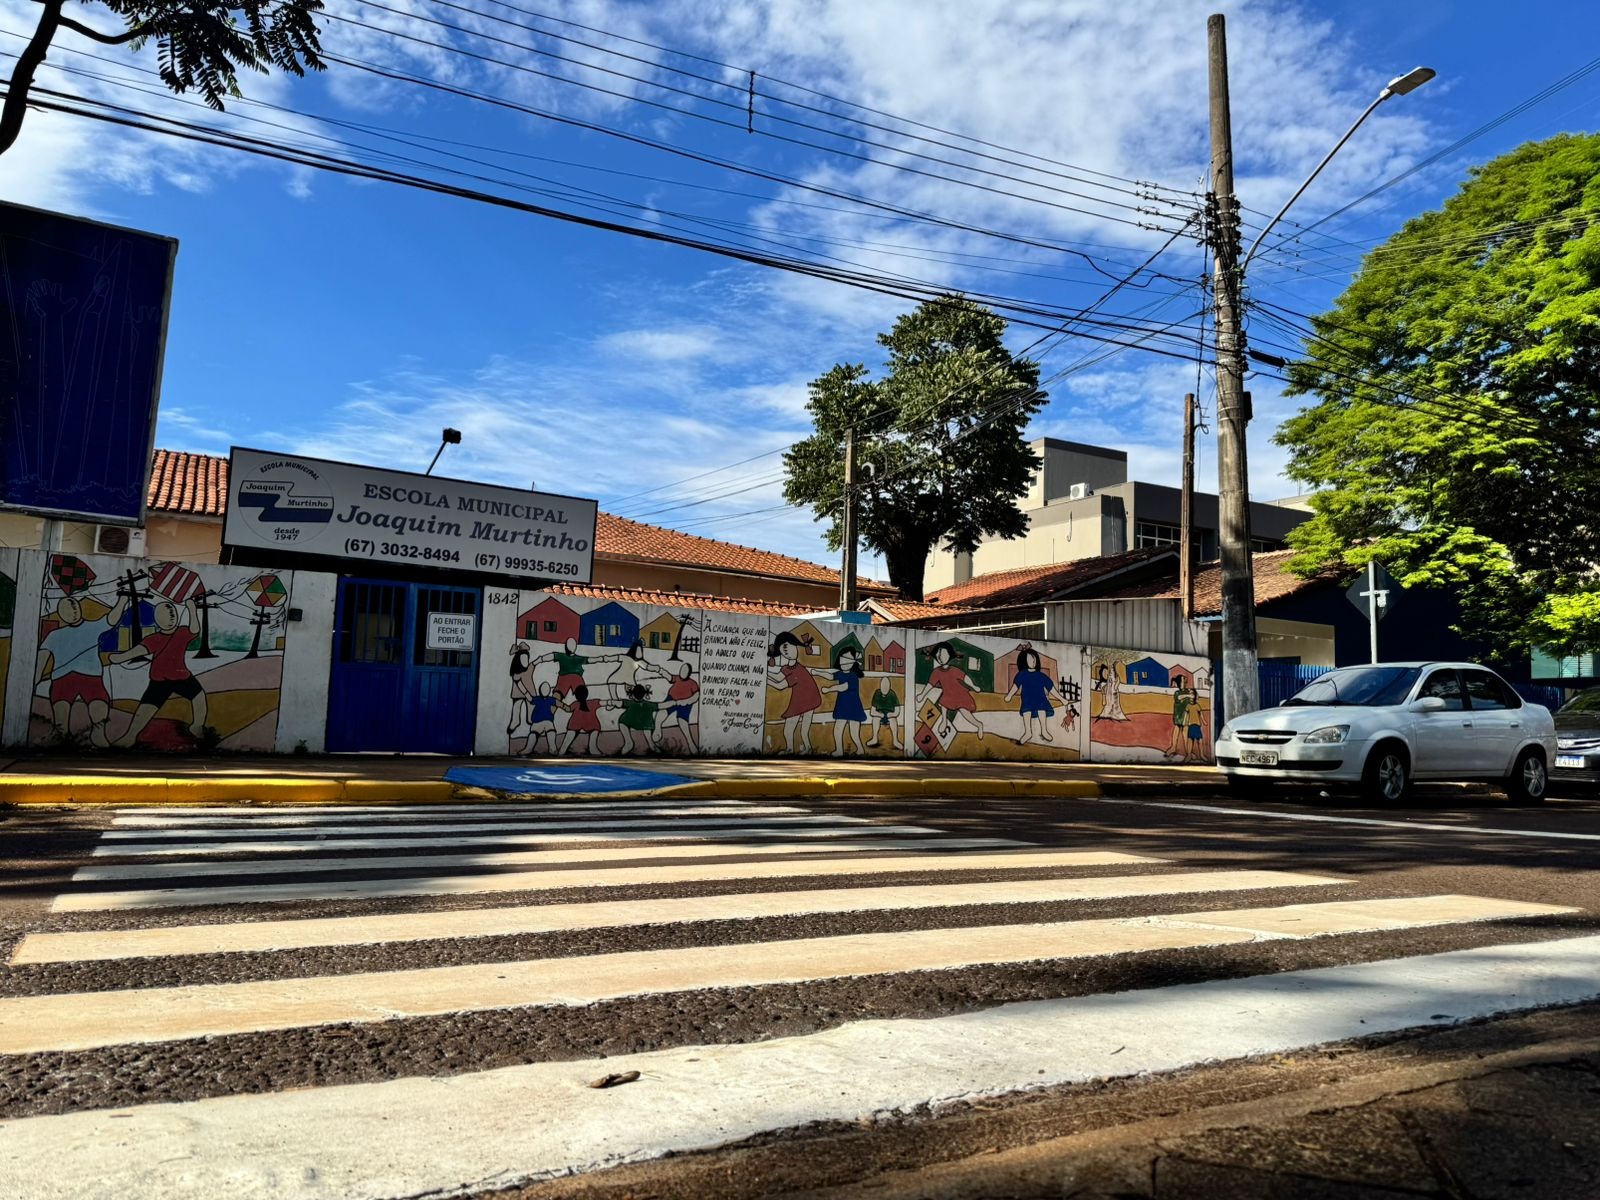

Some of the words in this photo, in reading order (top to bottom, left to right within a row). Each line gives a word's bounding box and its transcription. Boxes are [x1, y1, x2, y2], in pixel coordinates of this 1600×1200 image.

[260, 461, 284, 473] ESCOLA
[285, 462, 320, 480] MUNICIPAL
[246, 483, 285, 492] Joaquim
[363, 483, 450, 509] ESCOLA
[457, 496, 568, 524] MUNICIPAL
[337, 505, 462, 536] Joaquim
[469, 521, 588, 552] Murtinho
[345, 538, 375, 557] (67)
[380, 542, 460, 562] 3032-8494
[474, 553, 500, 570] (67)
[505, 557, 578, 576] 99935-6250
[488, 593, 518, 604] 1842
[742, 627, 754, 636] QUE
[438, 635, 464, 644] PORTÃO
[704, 636, 727, 645] BRINCA
[704, 648, 713, 656] AO
[715, 649, 737, 657] ADULTO
[741, 650, 756, 659] QUE
[702, 662, 727, 672] QUANDO
[702, 675, 729, 685] BRINCOU
[745, 690, 755, 699] NO
